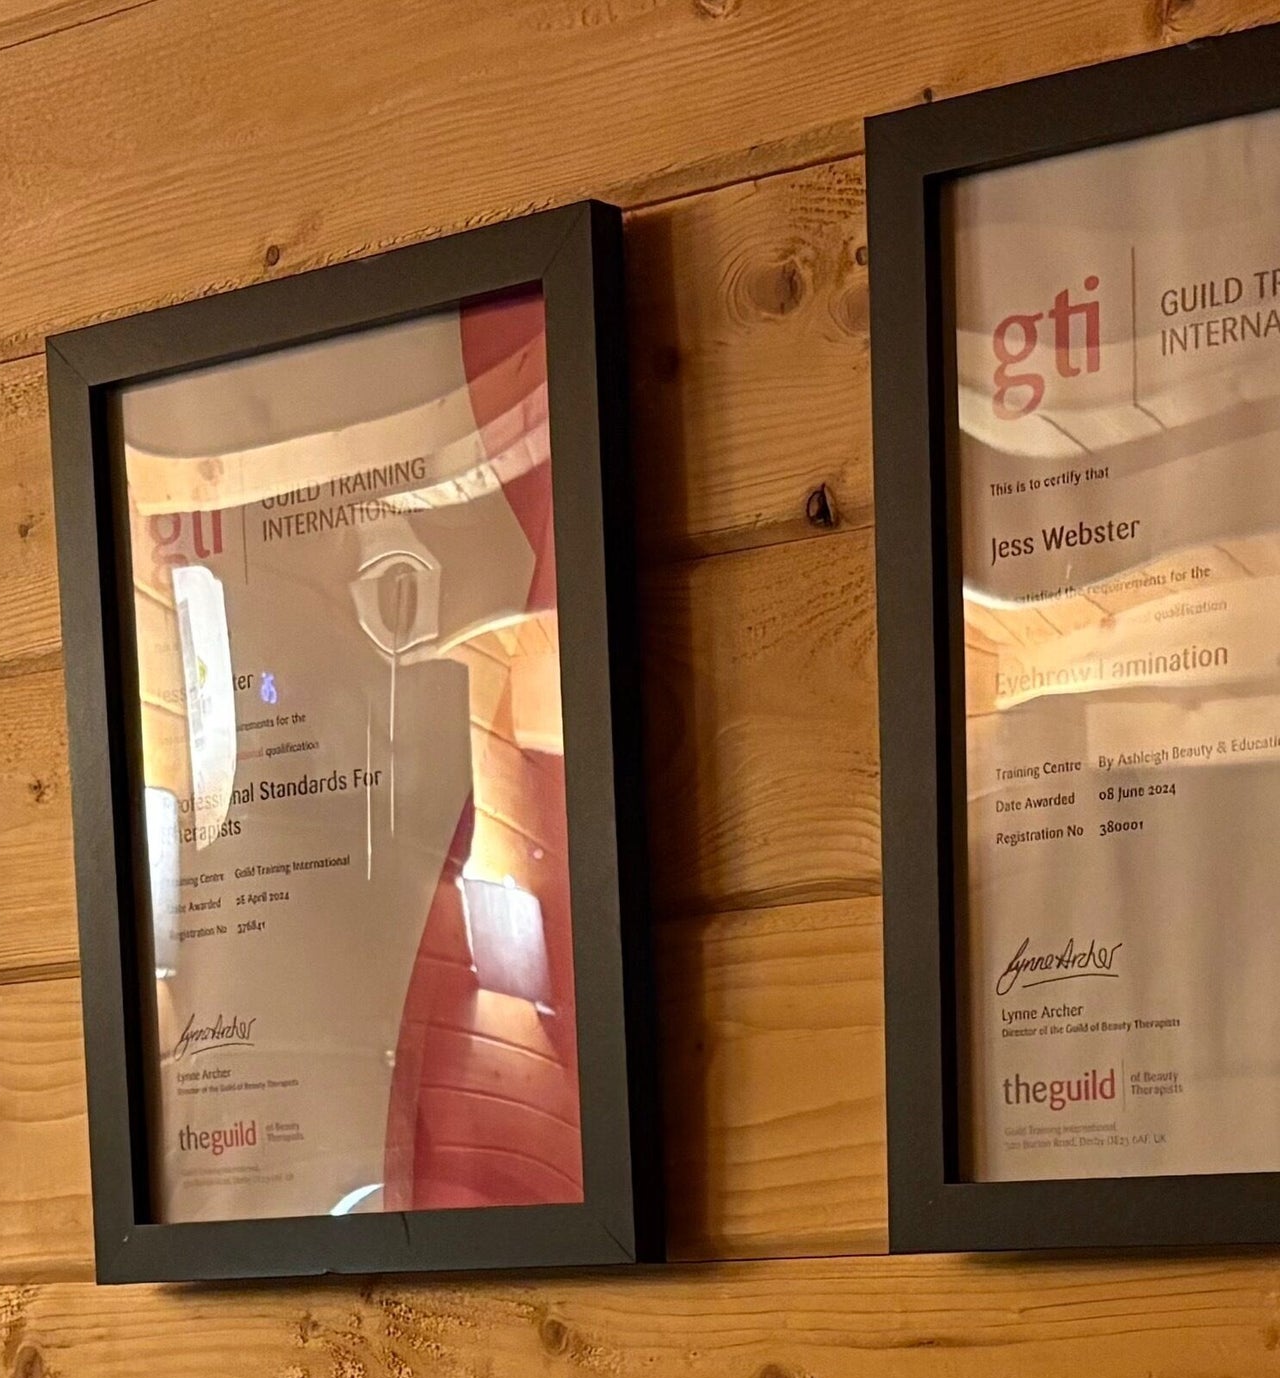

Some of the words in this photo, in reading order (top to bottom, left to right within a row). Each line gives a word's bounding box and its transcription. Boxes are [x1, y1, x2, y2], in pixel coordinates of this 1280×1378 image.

[1160, 277, 1243, 316] GUILD
[992, 275, 1100, 421] gti
[261, 484, 320, 510] GUILD
[330, 458, 426, 498] TRAINING
[990, 483, 1012, 496] This
[1016, 482, 1025, 492] is
[1030, 479, 1040, 490] to
[1044, 471, 1081, 486] certify
[1085, 466, 1109, 480] that
[262, 500, 424, 541] INTERNATIONAL
[991, 537, 1034, 565] Jess
[1042, 520, 1140, 551] Webster
[1170, 571, 1186, 582] for
[1191, 567, 1211, 579] the
[292, 713, 306, 724] the
[266, 742, 319, 758] qualification
[996, 765, 1040, 781] Training
[1043, 761, 1081, 775] Centre
[1099, 756, 1114, 770] By
[1118, 750, 1169, 767] Ashleigh
[1172, 745, 1212, 760] Beauty
[1216, 742, 1226, 754] &
[260, 770, 347, 800] Standards
[353, 768, 383, 788] For
[996, 800, 1021, 813] Date
[1025, 793, 1075, 809] Awarded
[1099, 788, 1114, 801] 08
[1118, 786, 1145, 801] June
[1148, 784, 1176, 796] 2024
[996, 828, 1064, 846] Registration
[1067, 825, 1083, 837] No
[1099, 820, 1144, 836] 380001
[257, 864, 290, 876] Training
[293, 855, 350, 870] International
[247, 892, 267, 904] April
[217, 925, 227, 934] No
[1002, 1008, 1037, 1024] Lynne
[1042, 1004, 1084, 1019] Archer
[1002, 1026, 1037, 1038] Director
[1066, 1024, 1088, 1034] Guild
[1090, 1022, 1099, 1031] of
[1102, 1021, 1132, 1032] Beauty
[1135, 1018, 1181, 1030] Therapists
[178, 1072, 200, 1083] Lynne
[202, 1068, 231, 1079] Archer
[1131, 1073, 1141, 1083] of
[1144, 1071, 1178, 1084] Beauty
[1131, 1083, 1183, 1096] Therapists
